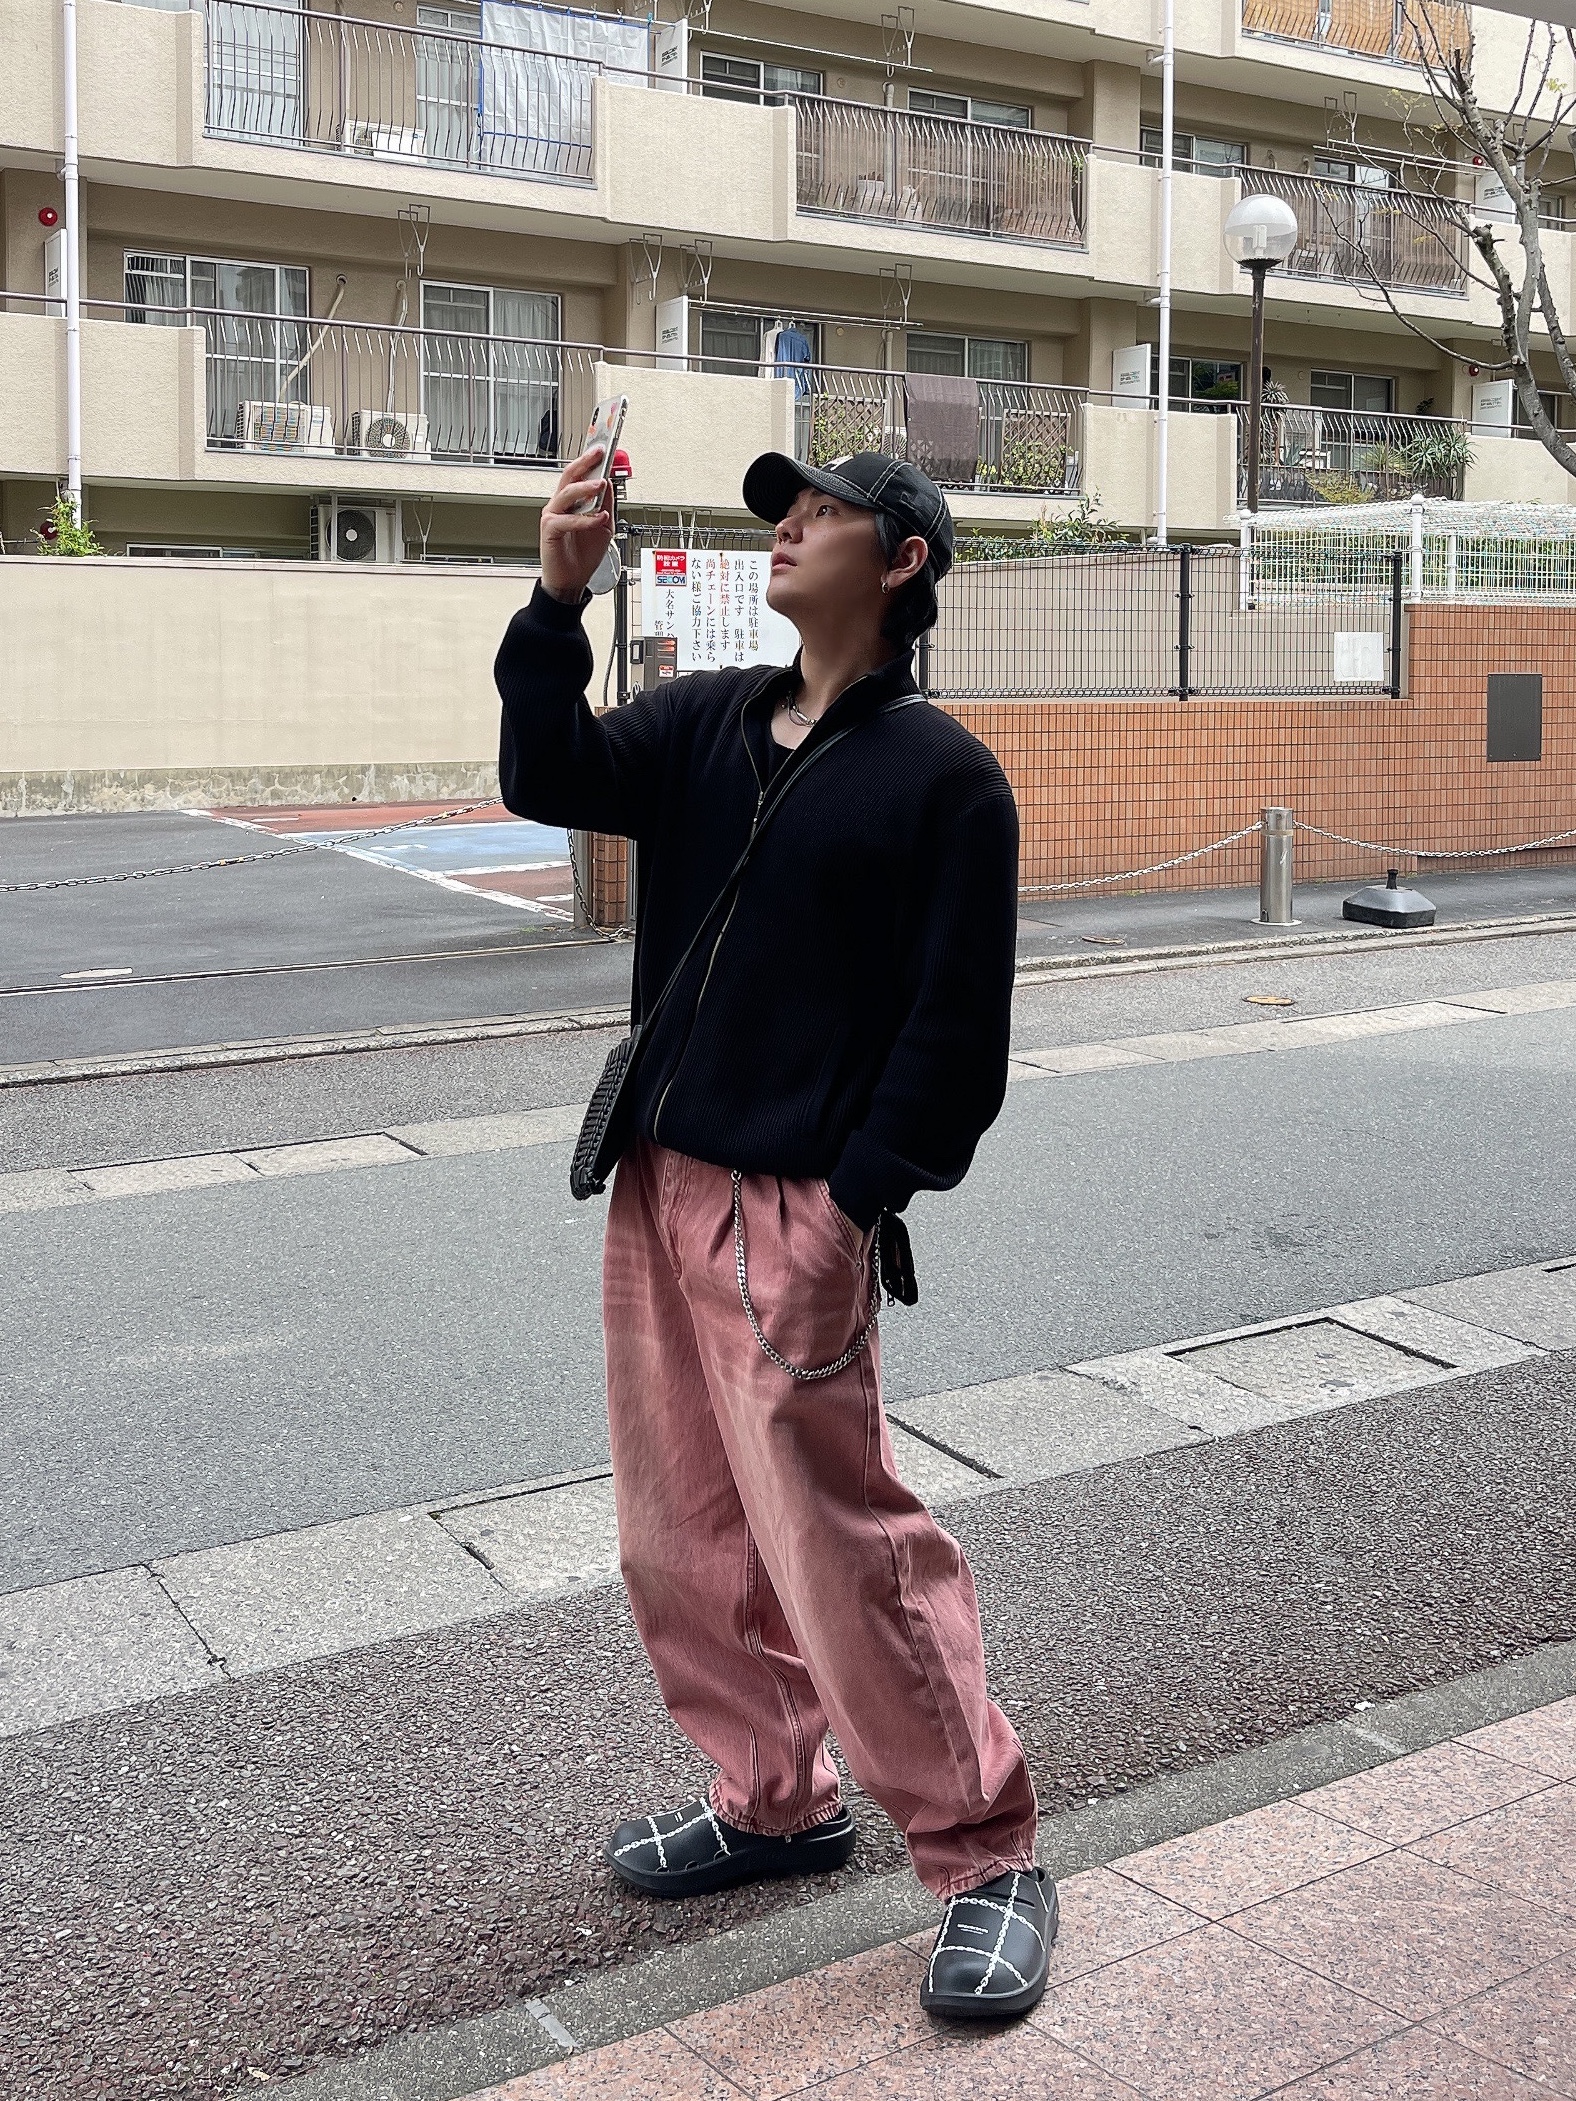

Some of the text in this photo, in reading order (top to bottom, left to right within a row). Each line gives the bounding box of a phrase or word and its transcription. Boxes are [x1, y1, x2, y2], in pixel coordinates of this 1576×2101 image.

[657, 575, 686, 584] SECOM
[691, 558, 702, 662] ない様ご協力下さい
[706, 559, 716, 663] 尚チェーンには乗ら
[720, 558, 730, 651] 絶対に禁止します
[734, 560, 745, 662] 出入口です 駐車は
[748, 560, 759, 652] この場所は駐車場
